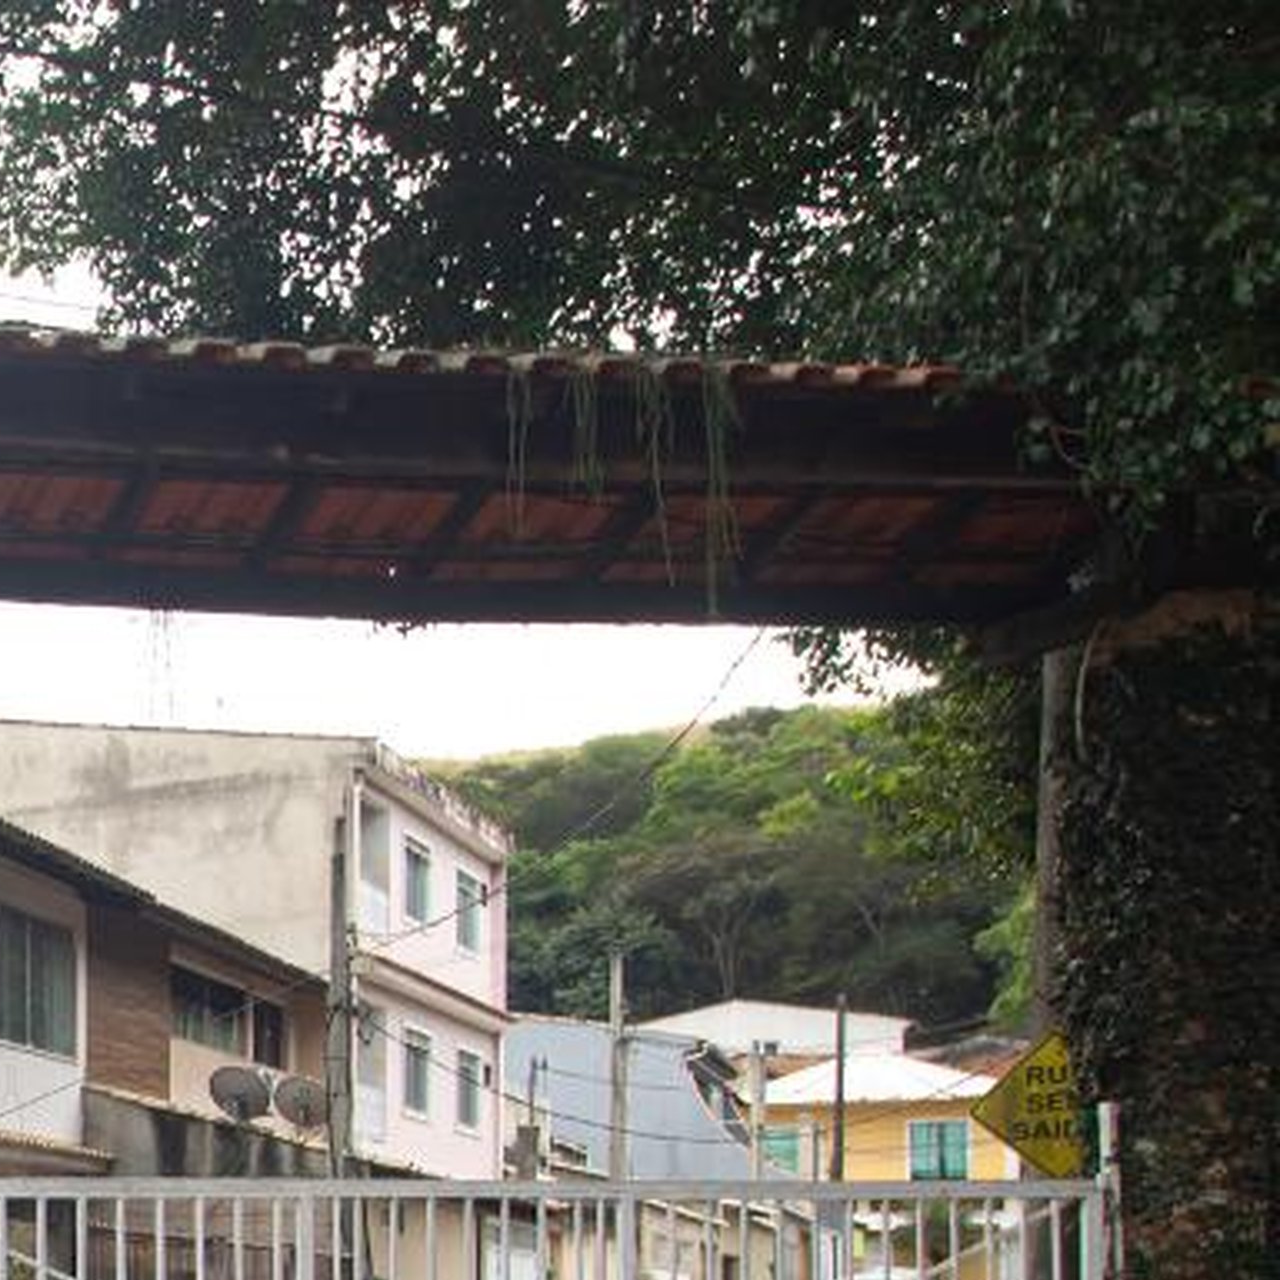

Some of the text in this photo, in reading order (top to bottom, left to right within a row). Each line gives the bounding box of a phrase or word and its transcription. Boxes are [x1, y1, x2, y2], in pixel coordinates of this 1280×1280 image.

[1026, 1066, 1068, 1086] RU
[1026, 1090, 1074, 1113] SE
[1013, 1119, 1073, 1140] SAI
